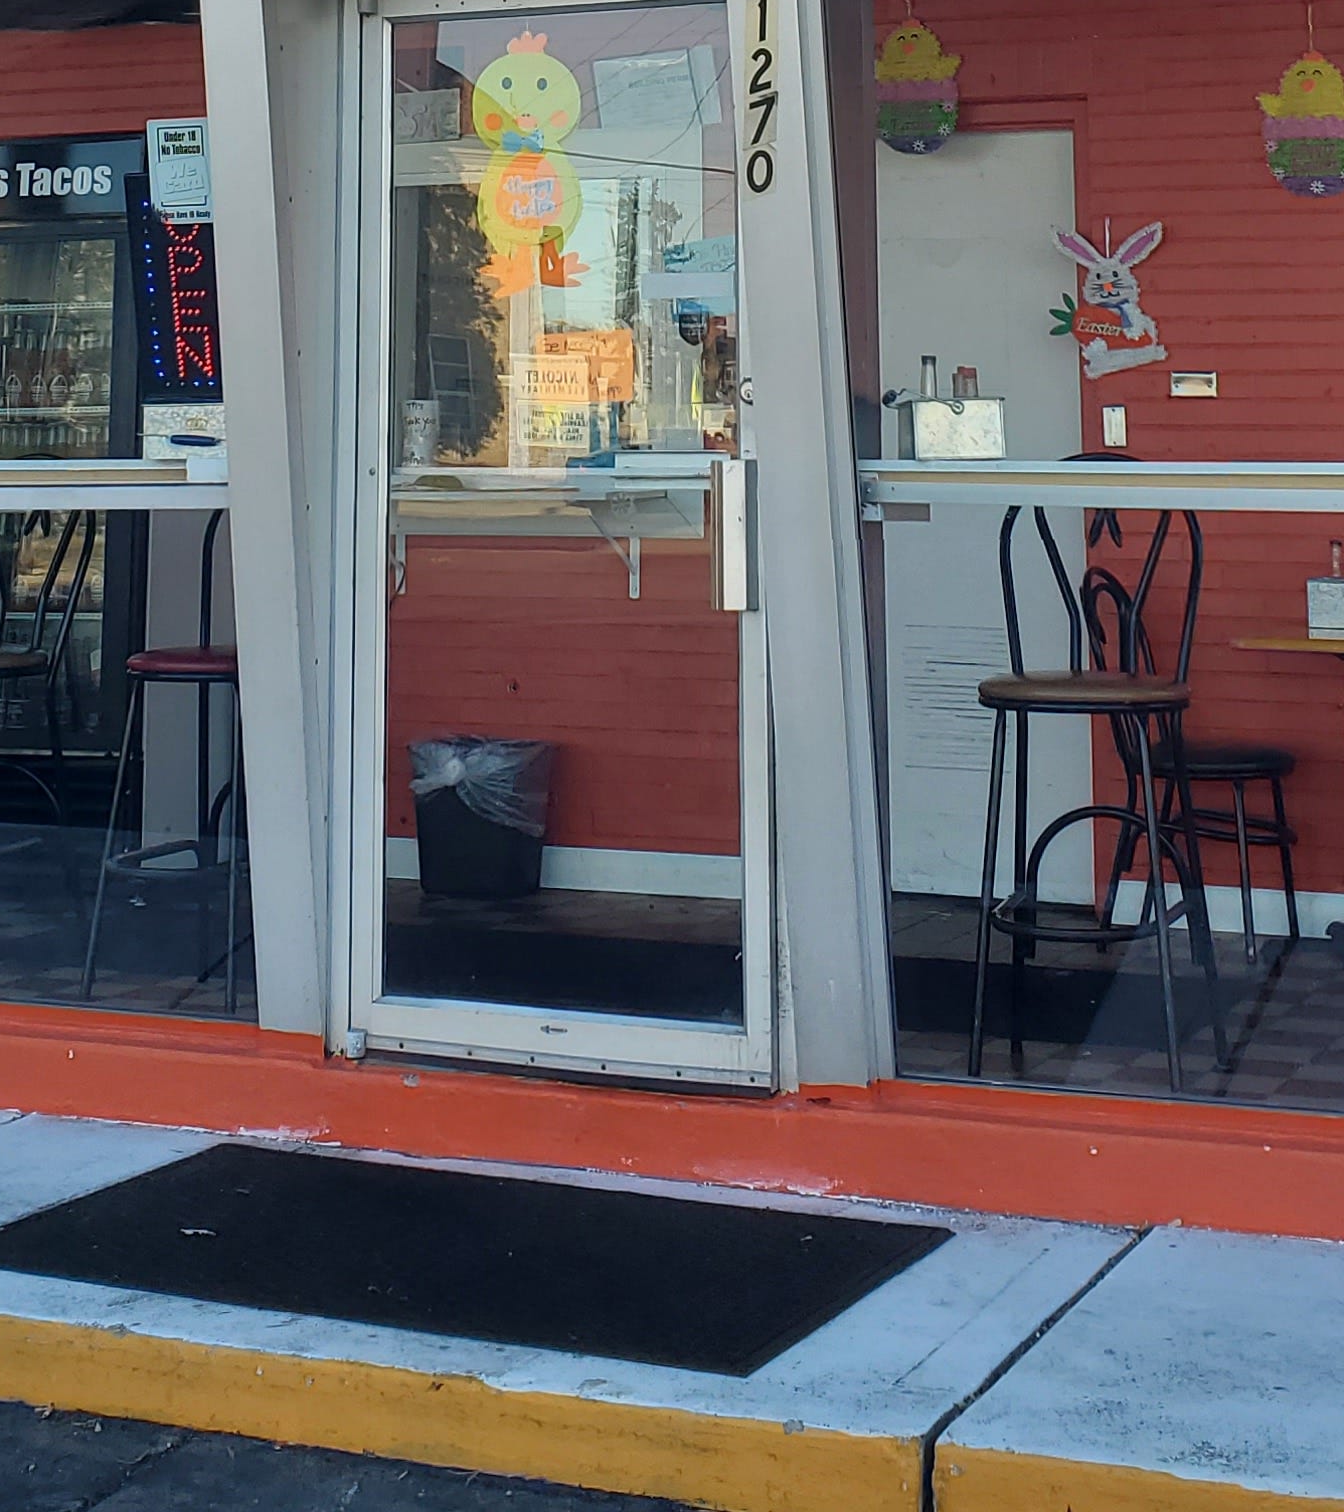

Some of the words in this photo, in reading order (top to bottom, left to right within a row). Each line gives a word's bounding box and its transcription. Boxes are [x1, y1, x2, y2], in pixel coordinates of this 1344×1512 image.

[161, 144, 171, 156] No
[16, 162, 112, 198] Tacos
[1078, 317, 1123, 336] Easter
